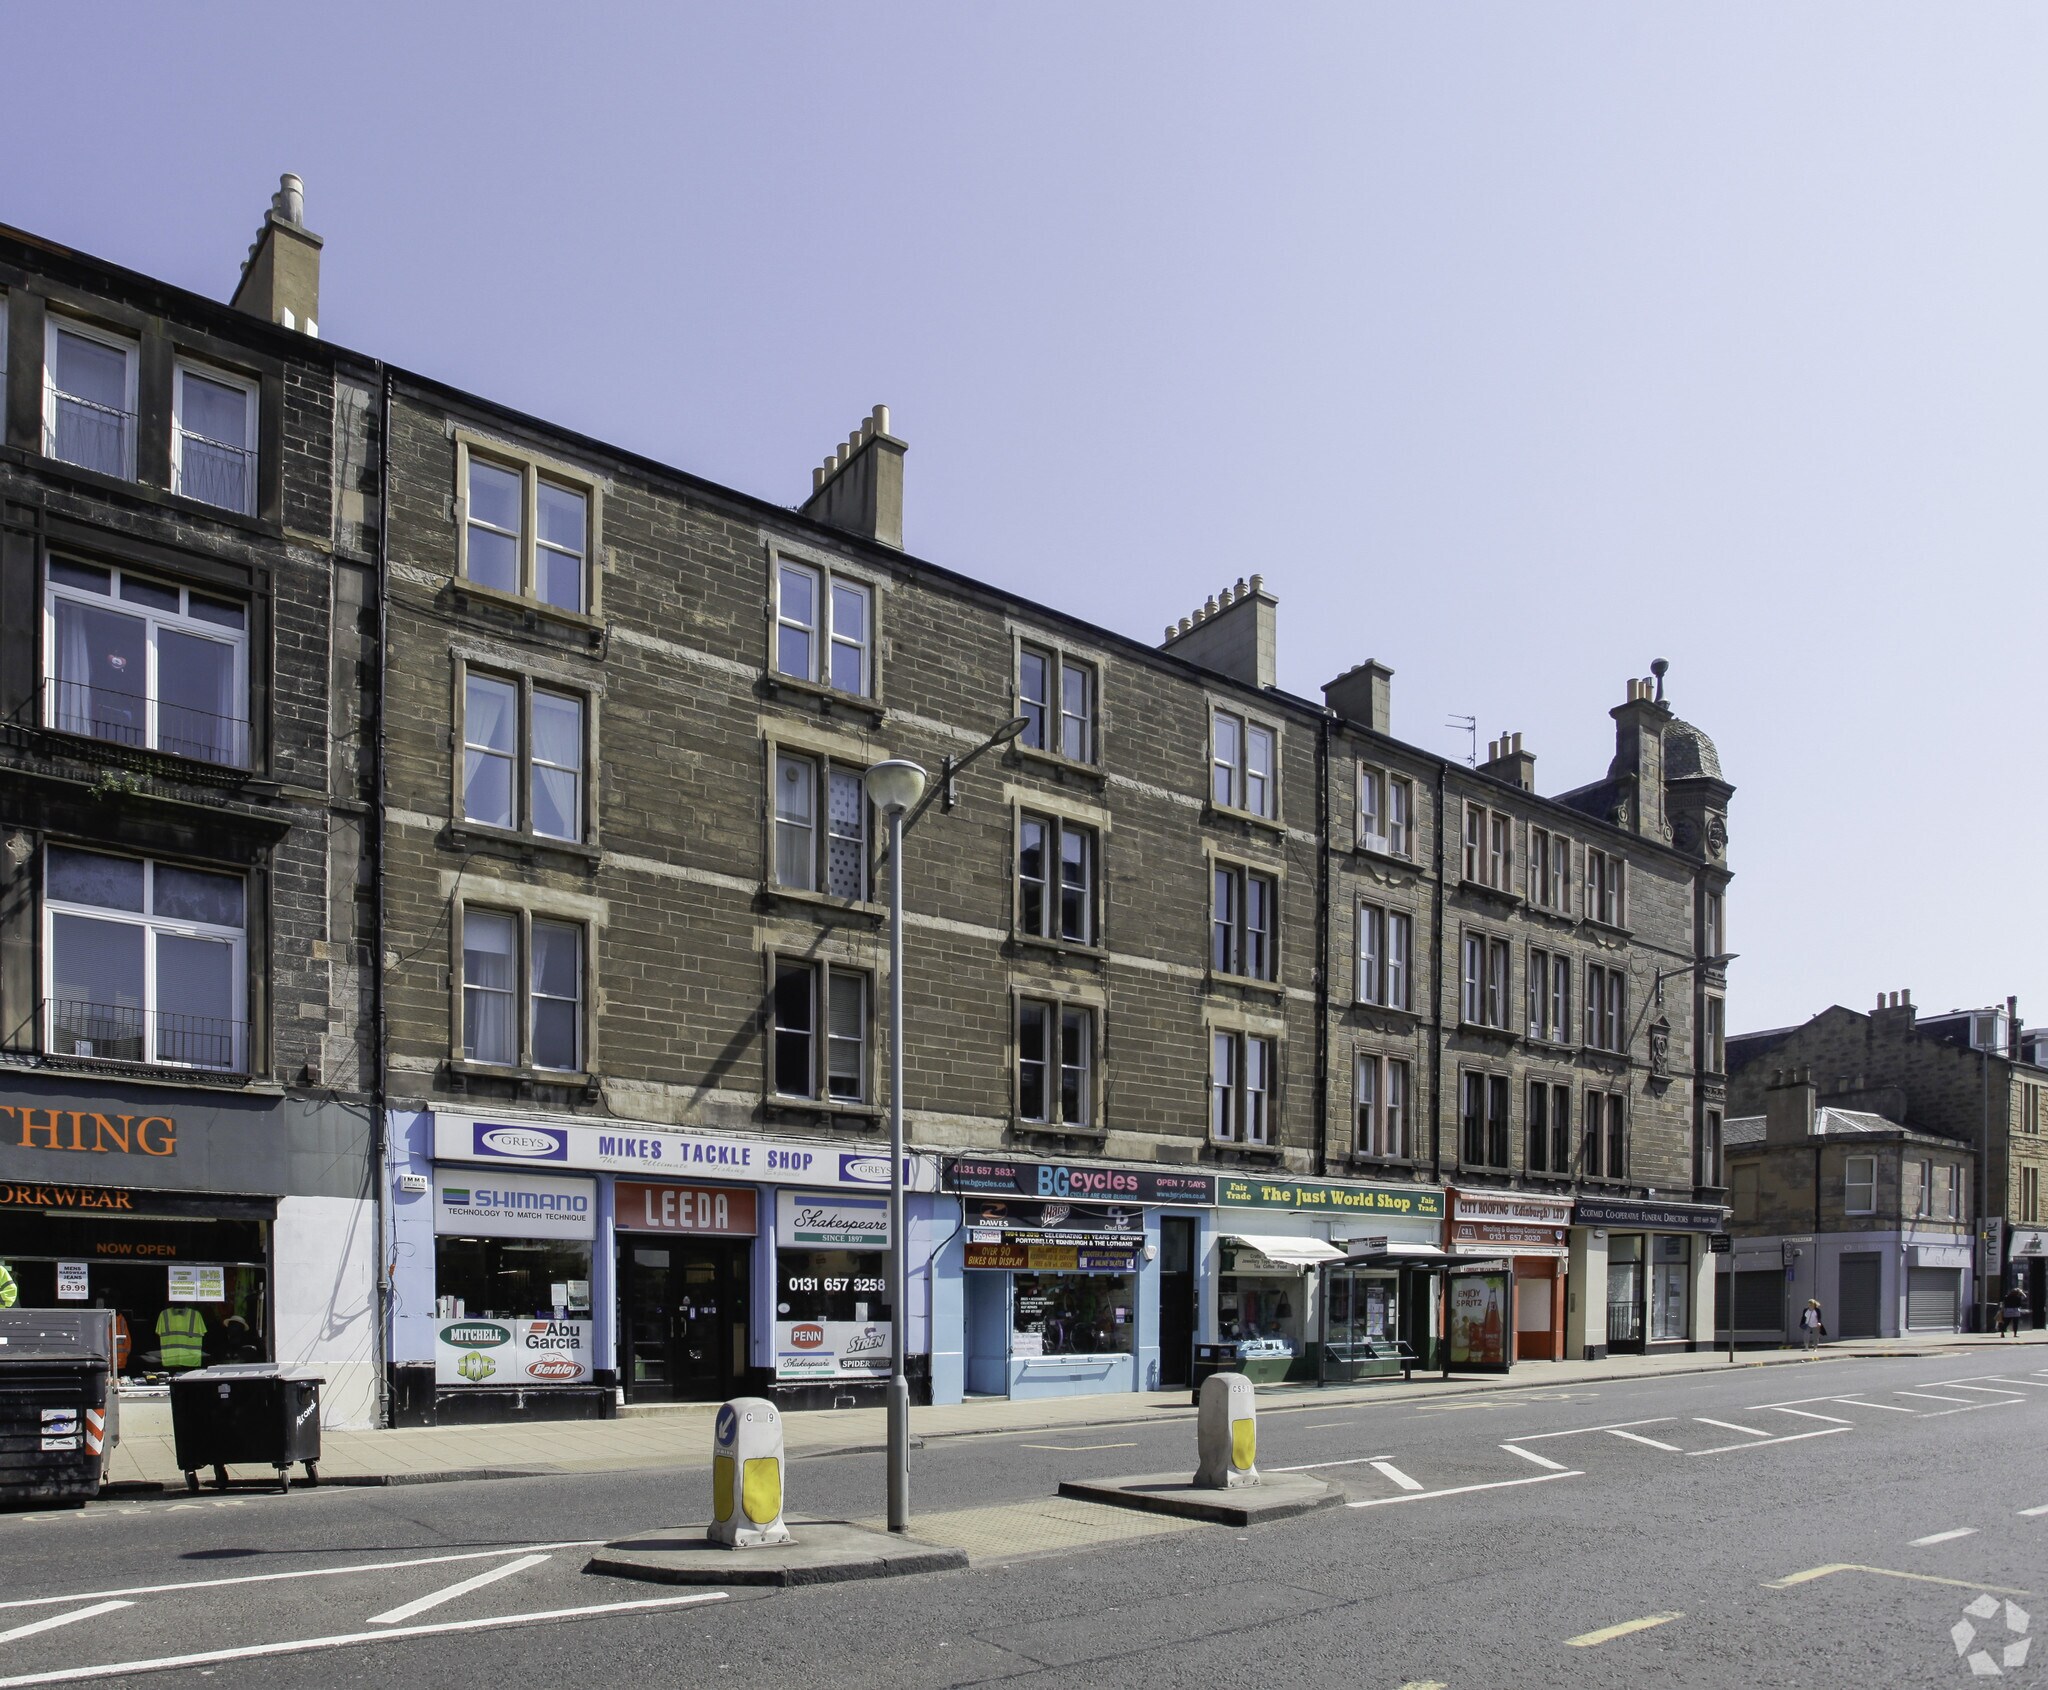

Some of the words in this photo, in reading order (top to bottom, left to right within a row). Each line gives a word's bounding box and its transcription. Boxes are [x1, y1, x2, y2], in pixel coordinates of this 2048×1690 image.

[502, 1136, 544, 1148] GREYS
[599, 1136, 662, 1159] MIKES
[680, 1143, 750, 1166] TACKLE
[767, 1150, 813, 1171] SHOP
[953, 1165, 975, 1174] 0131
[977, 1166, 991, 1175] 657
[1156, 1178, 1178, 1187] OPEN
[475, 1189, 588, 1212] SHIMANO
[1226, 1191, 1252, 1200] Trade
[1230, 1182, 1248, 1191] Fair
[1261, 1185, 1291, 1201] The
[1296, 1188, 1326, 1206] Just
[1330, 1190, 1374, 1207] World
[1377, 1193, 1411, 1212] Shop
[1421, 1196, 1435, 1204] Fair
[645, 1189, 729, 1229] LEEDA
[1418, 1204, 1438, 1212] Trade
[1460, 1201, 1478, 1214] CITY
[1478, 1202, 1509, 1215] ROOFING
[1512, 1205, 1550, 1220] (Edinburgh)
[1552, 1208, 1565, 1219] LTD
[448, 1208, 501, 1217] TECHNOLOGY
[517, 1211, 542, 1219] MATCH
[546, 1213, 587, 1222] TECHNIQUE
[794, 1208, 888, 1234] Shakespeare
[980, 1219, 1009, 1227] DAWES
[1482, 1225, 1501, 1234] Roofing
[1506, 1226, 1524, 1235] Building
[1524, 1226, 1552, 1235] Contractors
[822, 1234, 846, 1242] SINCE
[848, 1235, 863, 1243] 1897
[1524, 1234, 1541, 1242] 3030
[97, 1242, 132, 1254] NOW
[136, 1244, 176, 1256] OPEN
[981, 1247, 998, 1255] OVER
[1001, 1247, 1011, 1256] 90
[968, 1256, 986, 1265] BIKES
[988, 1257, 998, 1266] ON
[1000, 1257, 1024, 1266] DISPLAY
[60, 1284, 86, 1292] £9.99
[789, 1277, 818, 1292] 0131
[824, 1278, 849, 1292] 657
[853, 1278, 886, 1292] 3258
[1458, 1288, 1481, 1299] ENJOY
[1456, 1299, 1483, 1307] SPRITZ
[451, 1328, 501, 1341] MITCHELL
[546, 1322, 580, 1336] Abu
[525, 1335, 581, 1349] Garcia
[793, 1331, 822, 1342] PENN
[846, 1333, 886, 1353] STREN
[783, 1358, 830, 1369] Shakespeare
[533, 1363, 579, 1377] Berkley
[746, 1413, 752, 1422] C
[768, 1413, 774, 1423] 9
[22, 1500, 247, 1522] CLEAR
